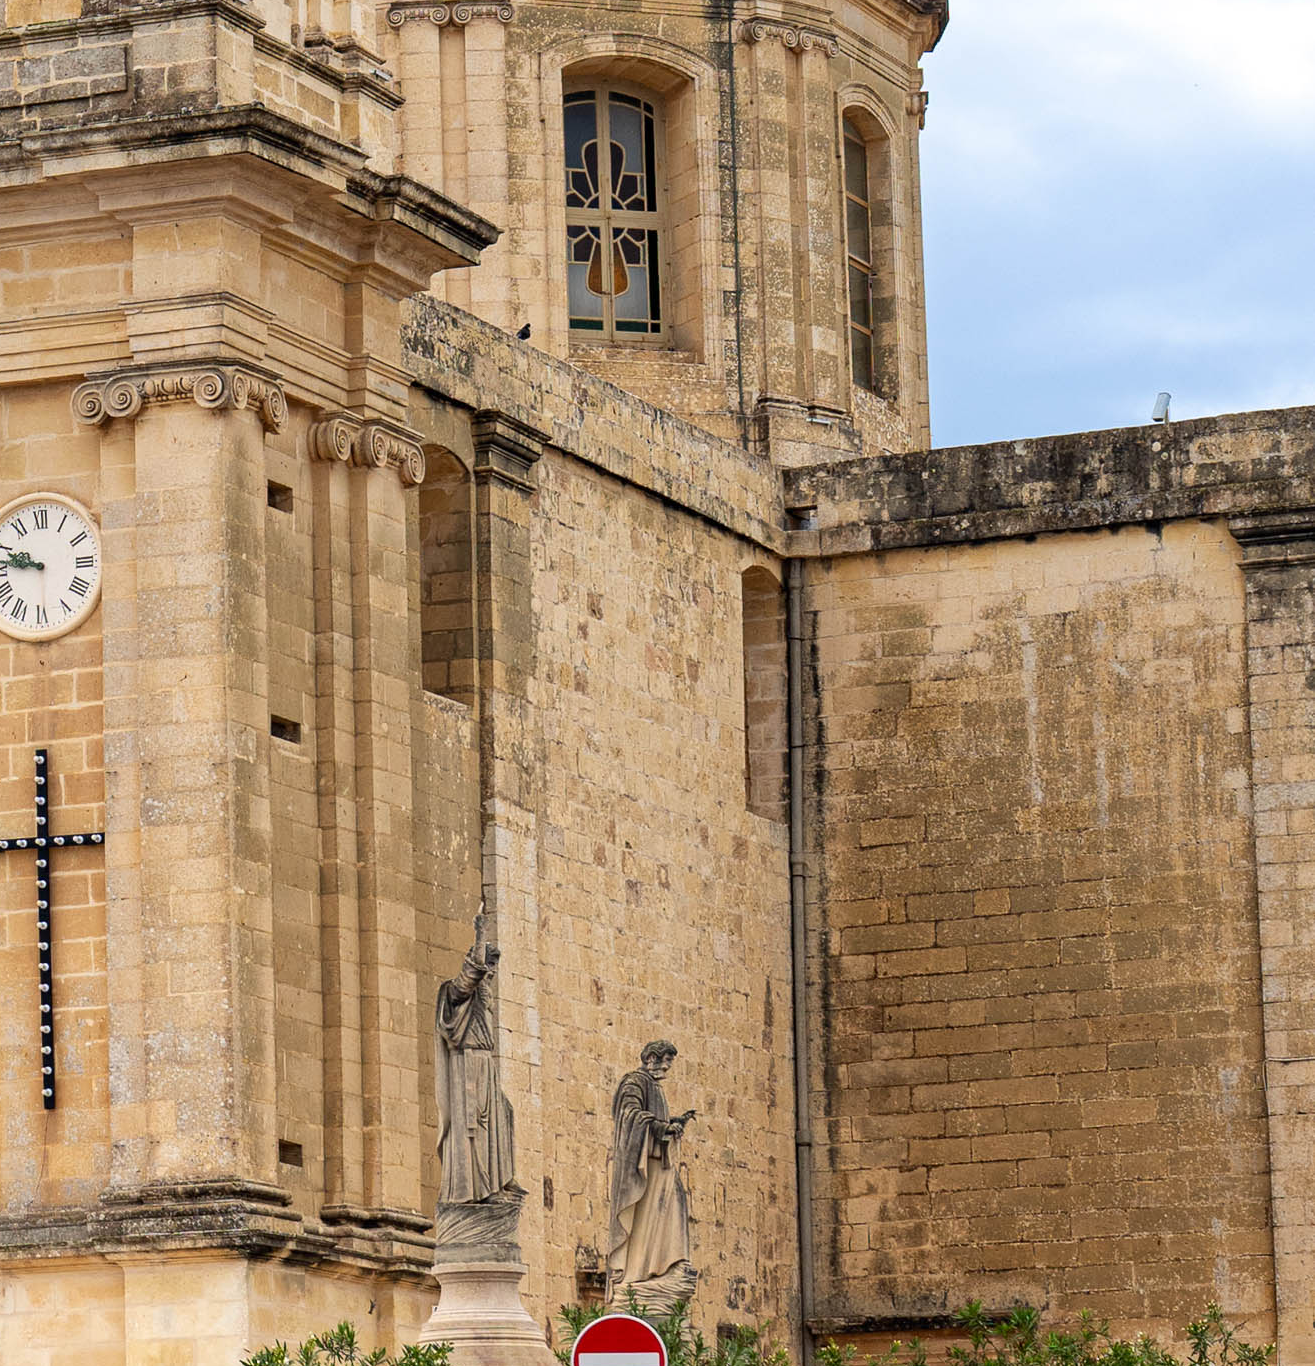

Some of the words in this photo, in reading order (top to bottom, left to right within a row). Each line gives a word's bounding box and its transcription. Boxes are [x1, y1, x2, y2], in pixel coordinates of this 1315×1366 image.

[11, 518, 28, 539] XI
[33, 510, 49, 530] XII
[57, 515, 67, 533] I
[70, 531, 87, 547] II
[76, 555, 93, 569] III
[69, 576, 90, 597] IIII
[11, 597, 27, 622] VII
[37, 605, 48, 624] VI
[60, 598, 72, 615] V
